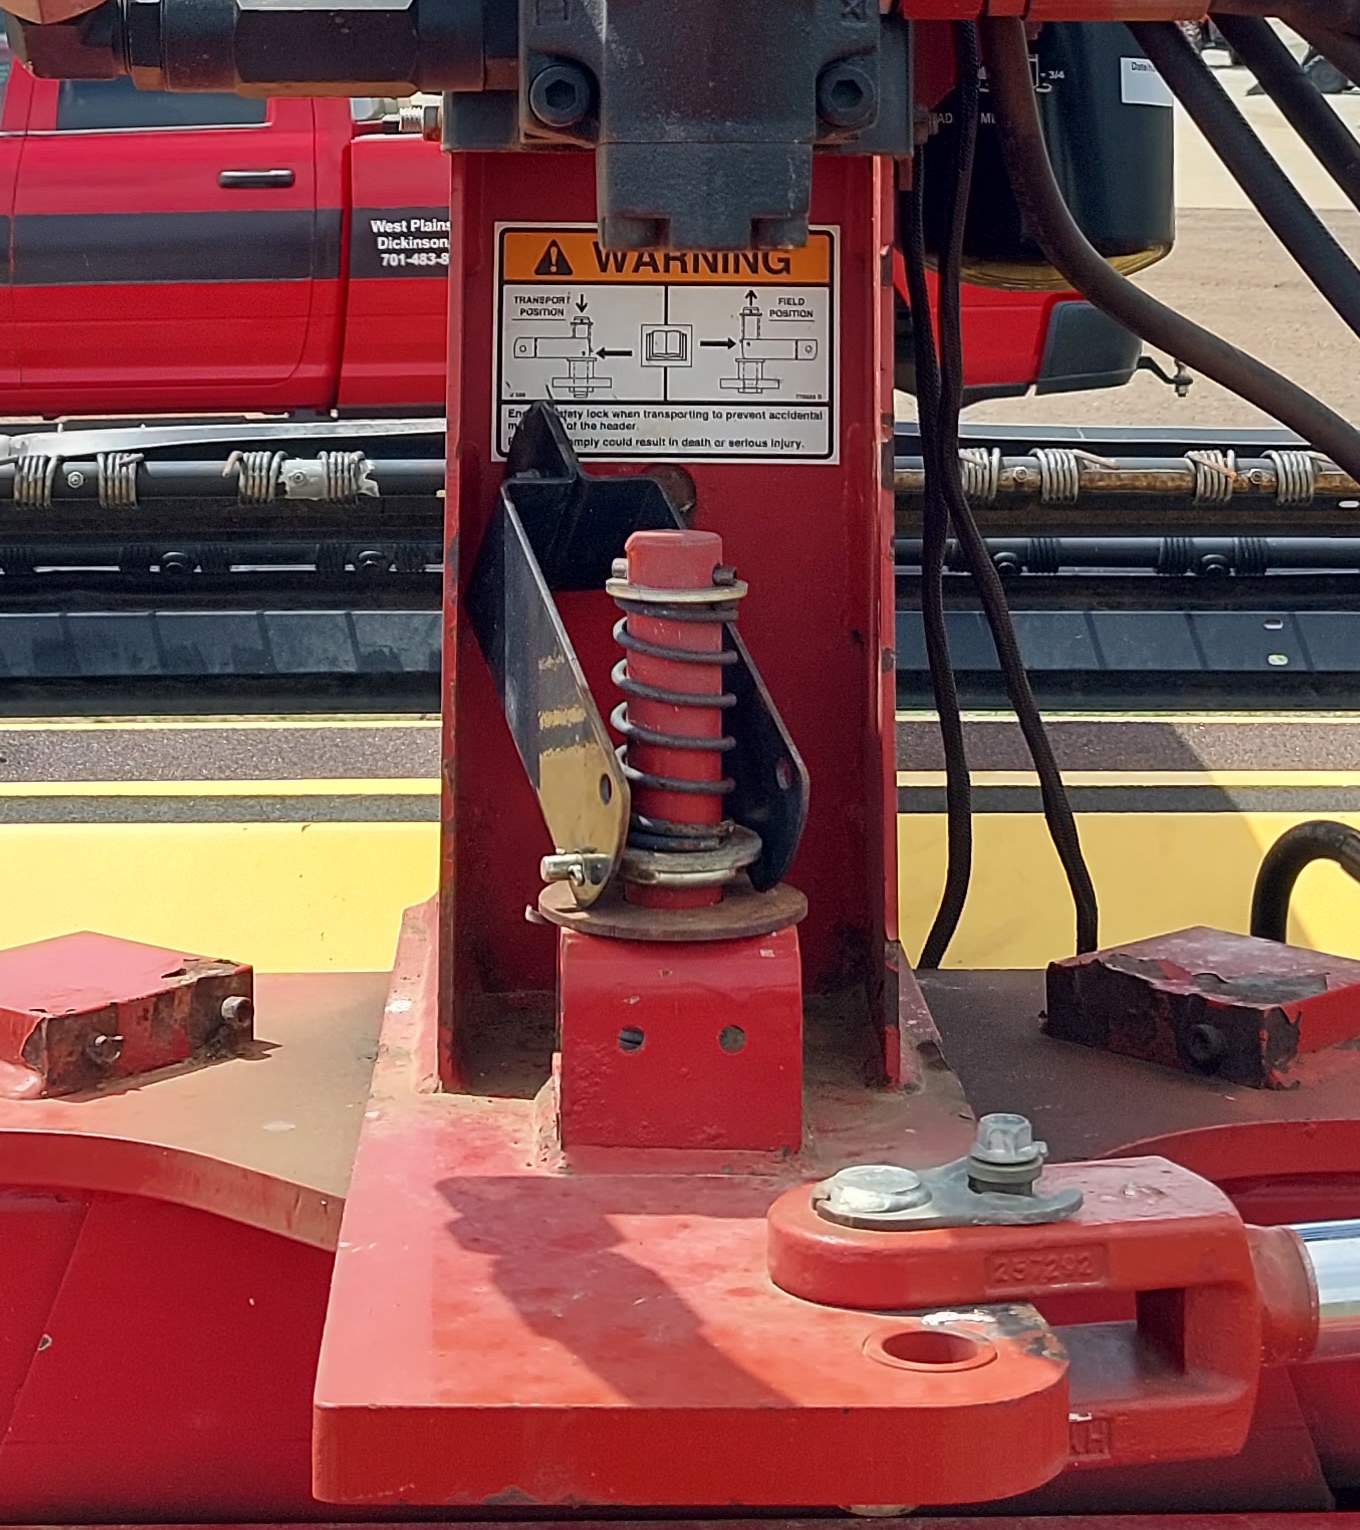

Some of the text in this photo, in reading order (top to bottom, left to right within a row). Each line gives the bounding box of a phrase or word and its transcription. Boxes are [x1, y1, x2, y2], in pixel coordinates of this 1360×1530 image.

[370, 220, 407, 233] West
[592, 240, 791, 275] WARNING
[513, 295, 572, 306] TRANSPORT
[778, 297, 806, 307] FIELD
[519, 307, 565, 318] POSITION
[769, 308, 815, 319] POSITION
[587, 409, 609, 419] lock
[612, 409, 640, 419] when
[643, 409, 709, 422] transporting
[712, 410, 723, 420] to
[725, 410, 766, 422] prevent
[769, 410, 823, 421] accidental
[566, 422, 577, 431] of
[580, 422, 597, 431] the
[602, 436, 633, 447] could
[636, 437, 665, 447] result
[668, 437, 678, 447] in
[681, 437, 711, 448] death
[714, 439, 726, 448] or
[728, 437, 768, 448] serious
